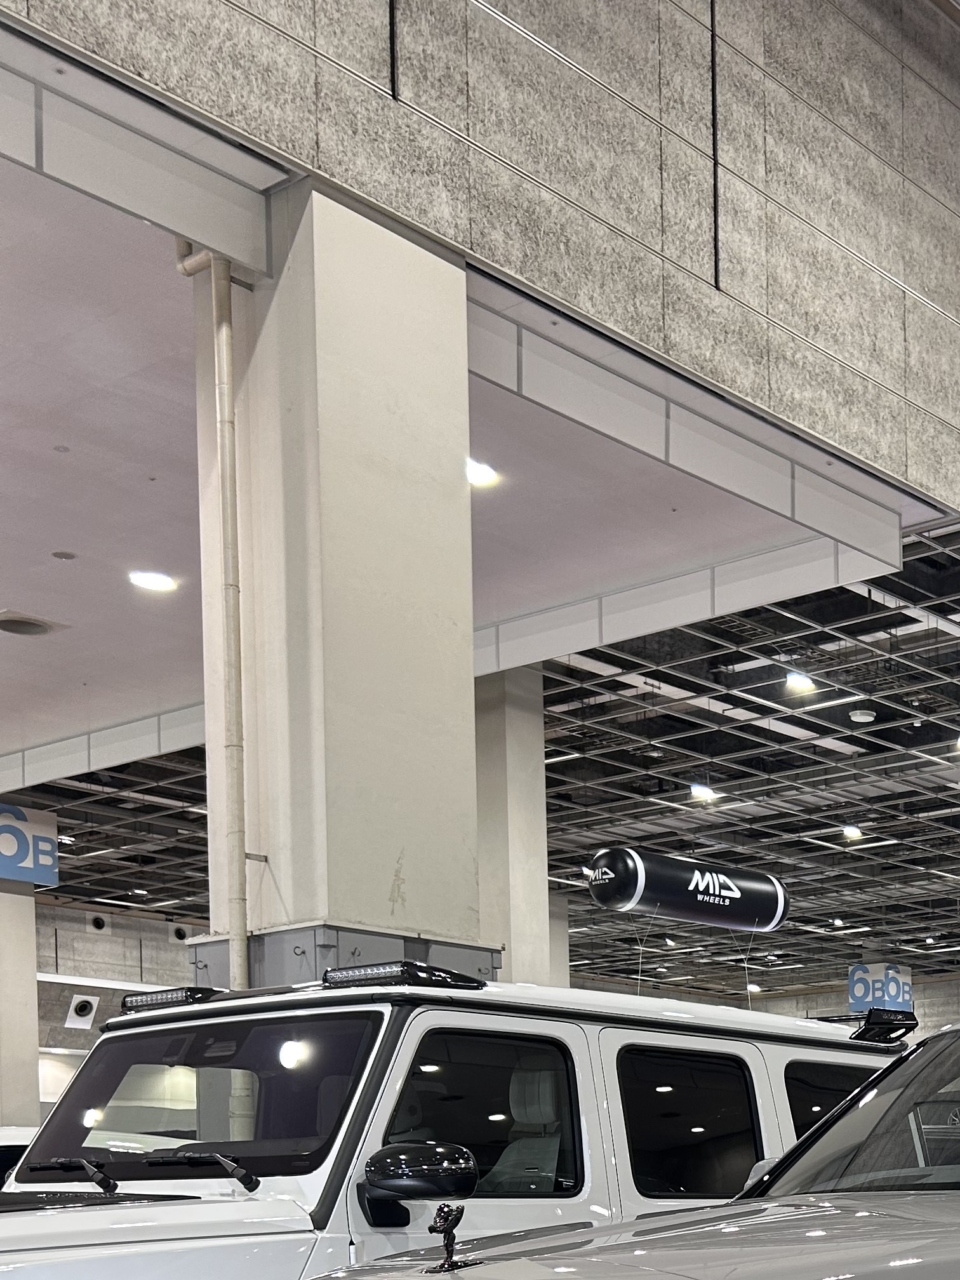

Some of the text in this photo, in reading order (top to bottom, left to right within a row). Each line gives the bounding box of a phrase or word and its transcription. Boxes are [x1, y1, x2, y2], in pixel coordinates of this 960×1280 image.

[687, 869, 742, 899] MID
[697, 893, 731, 906] WHEELS
[849, 964, 885, 1002] 6B
[885, 964, 912, 1003] 6B
